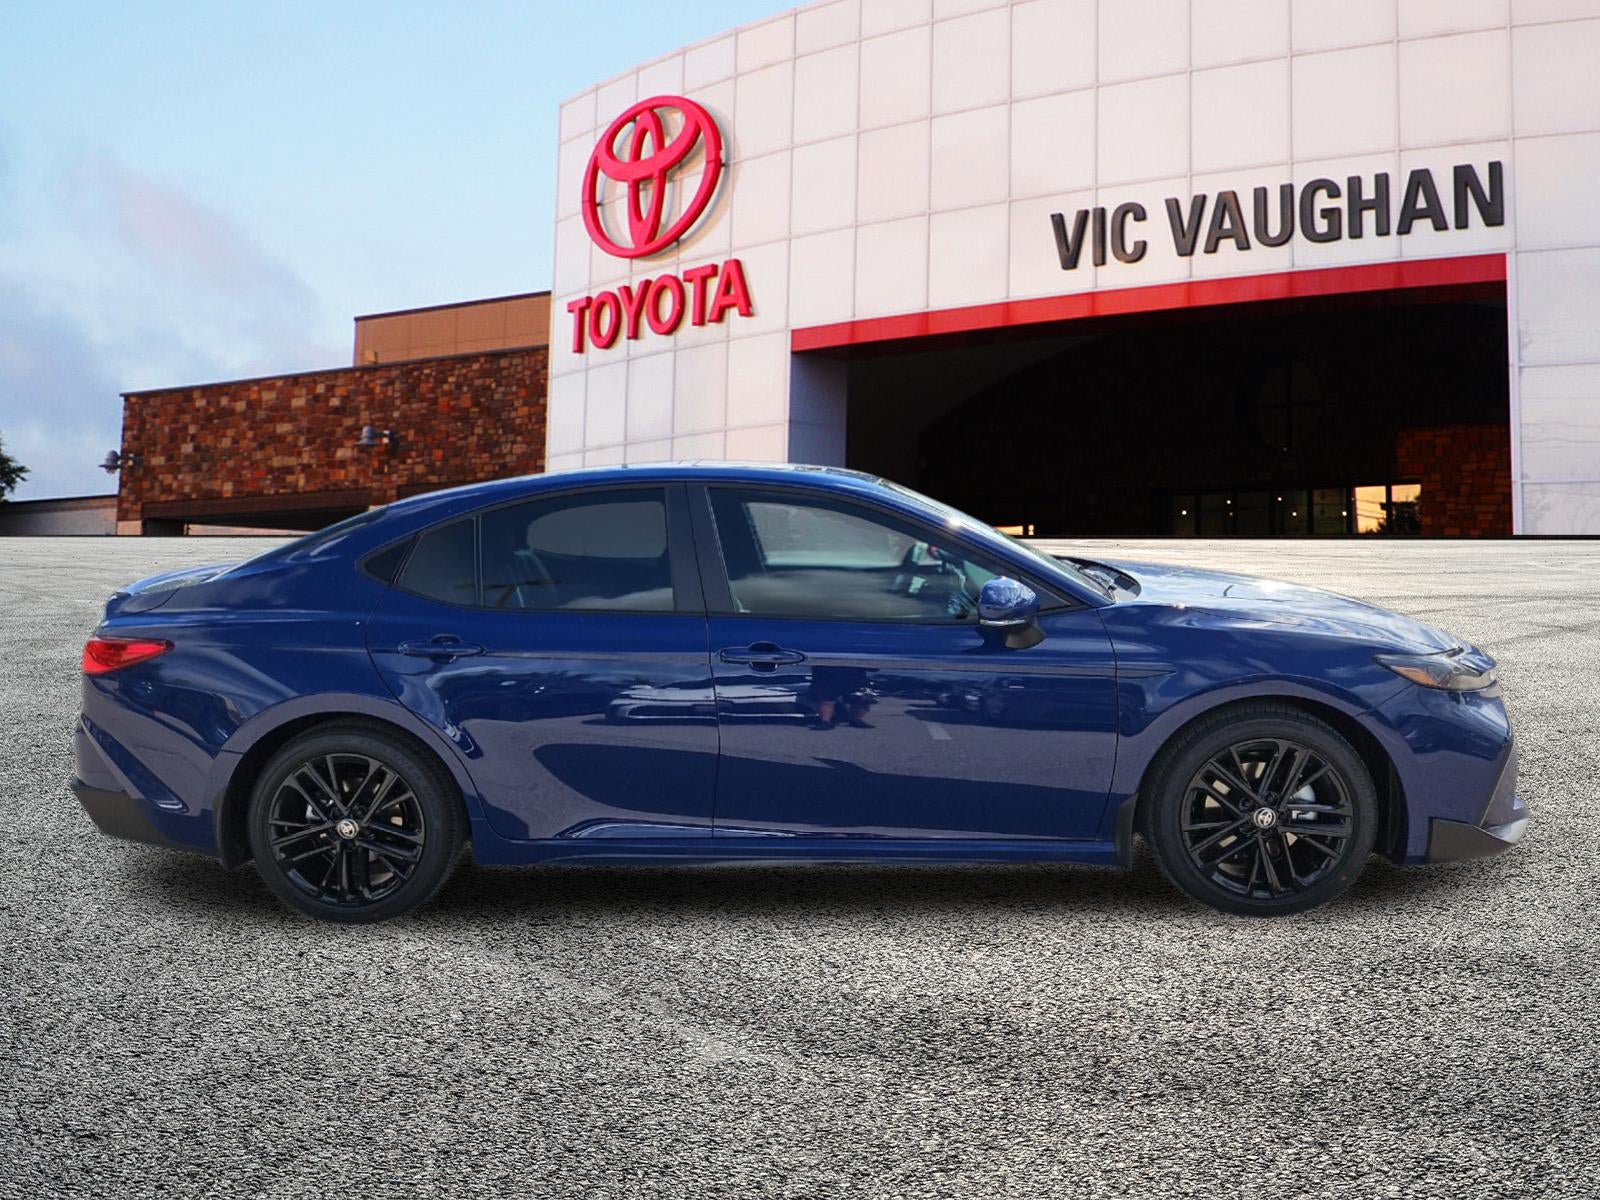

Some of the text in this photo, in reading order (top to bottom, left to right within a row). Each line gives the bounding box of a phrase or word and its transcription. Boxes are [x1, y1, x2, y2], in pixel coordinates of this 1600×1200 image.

[1051, 161, 1505, 271] VIC VAUGHAN
[567, 258, 754, 354] TOYOTA
